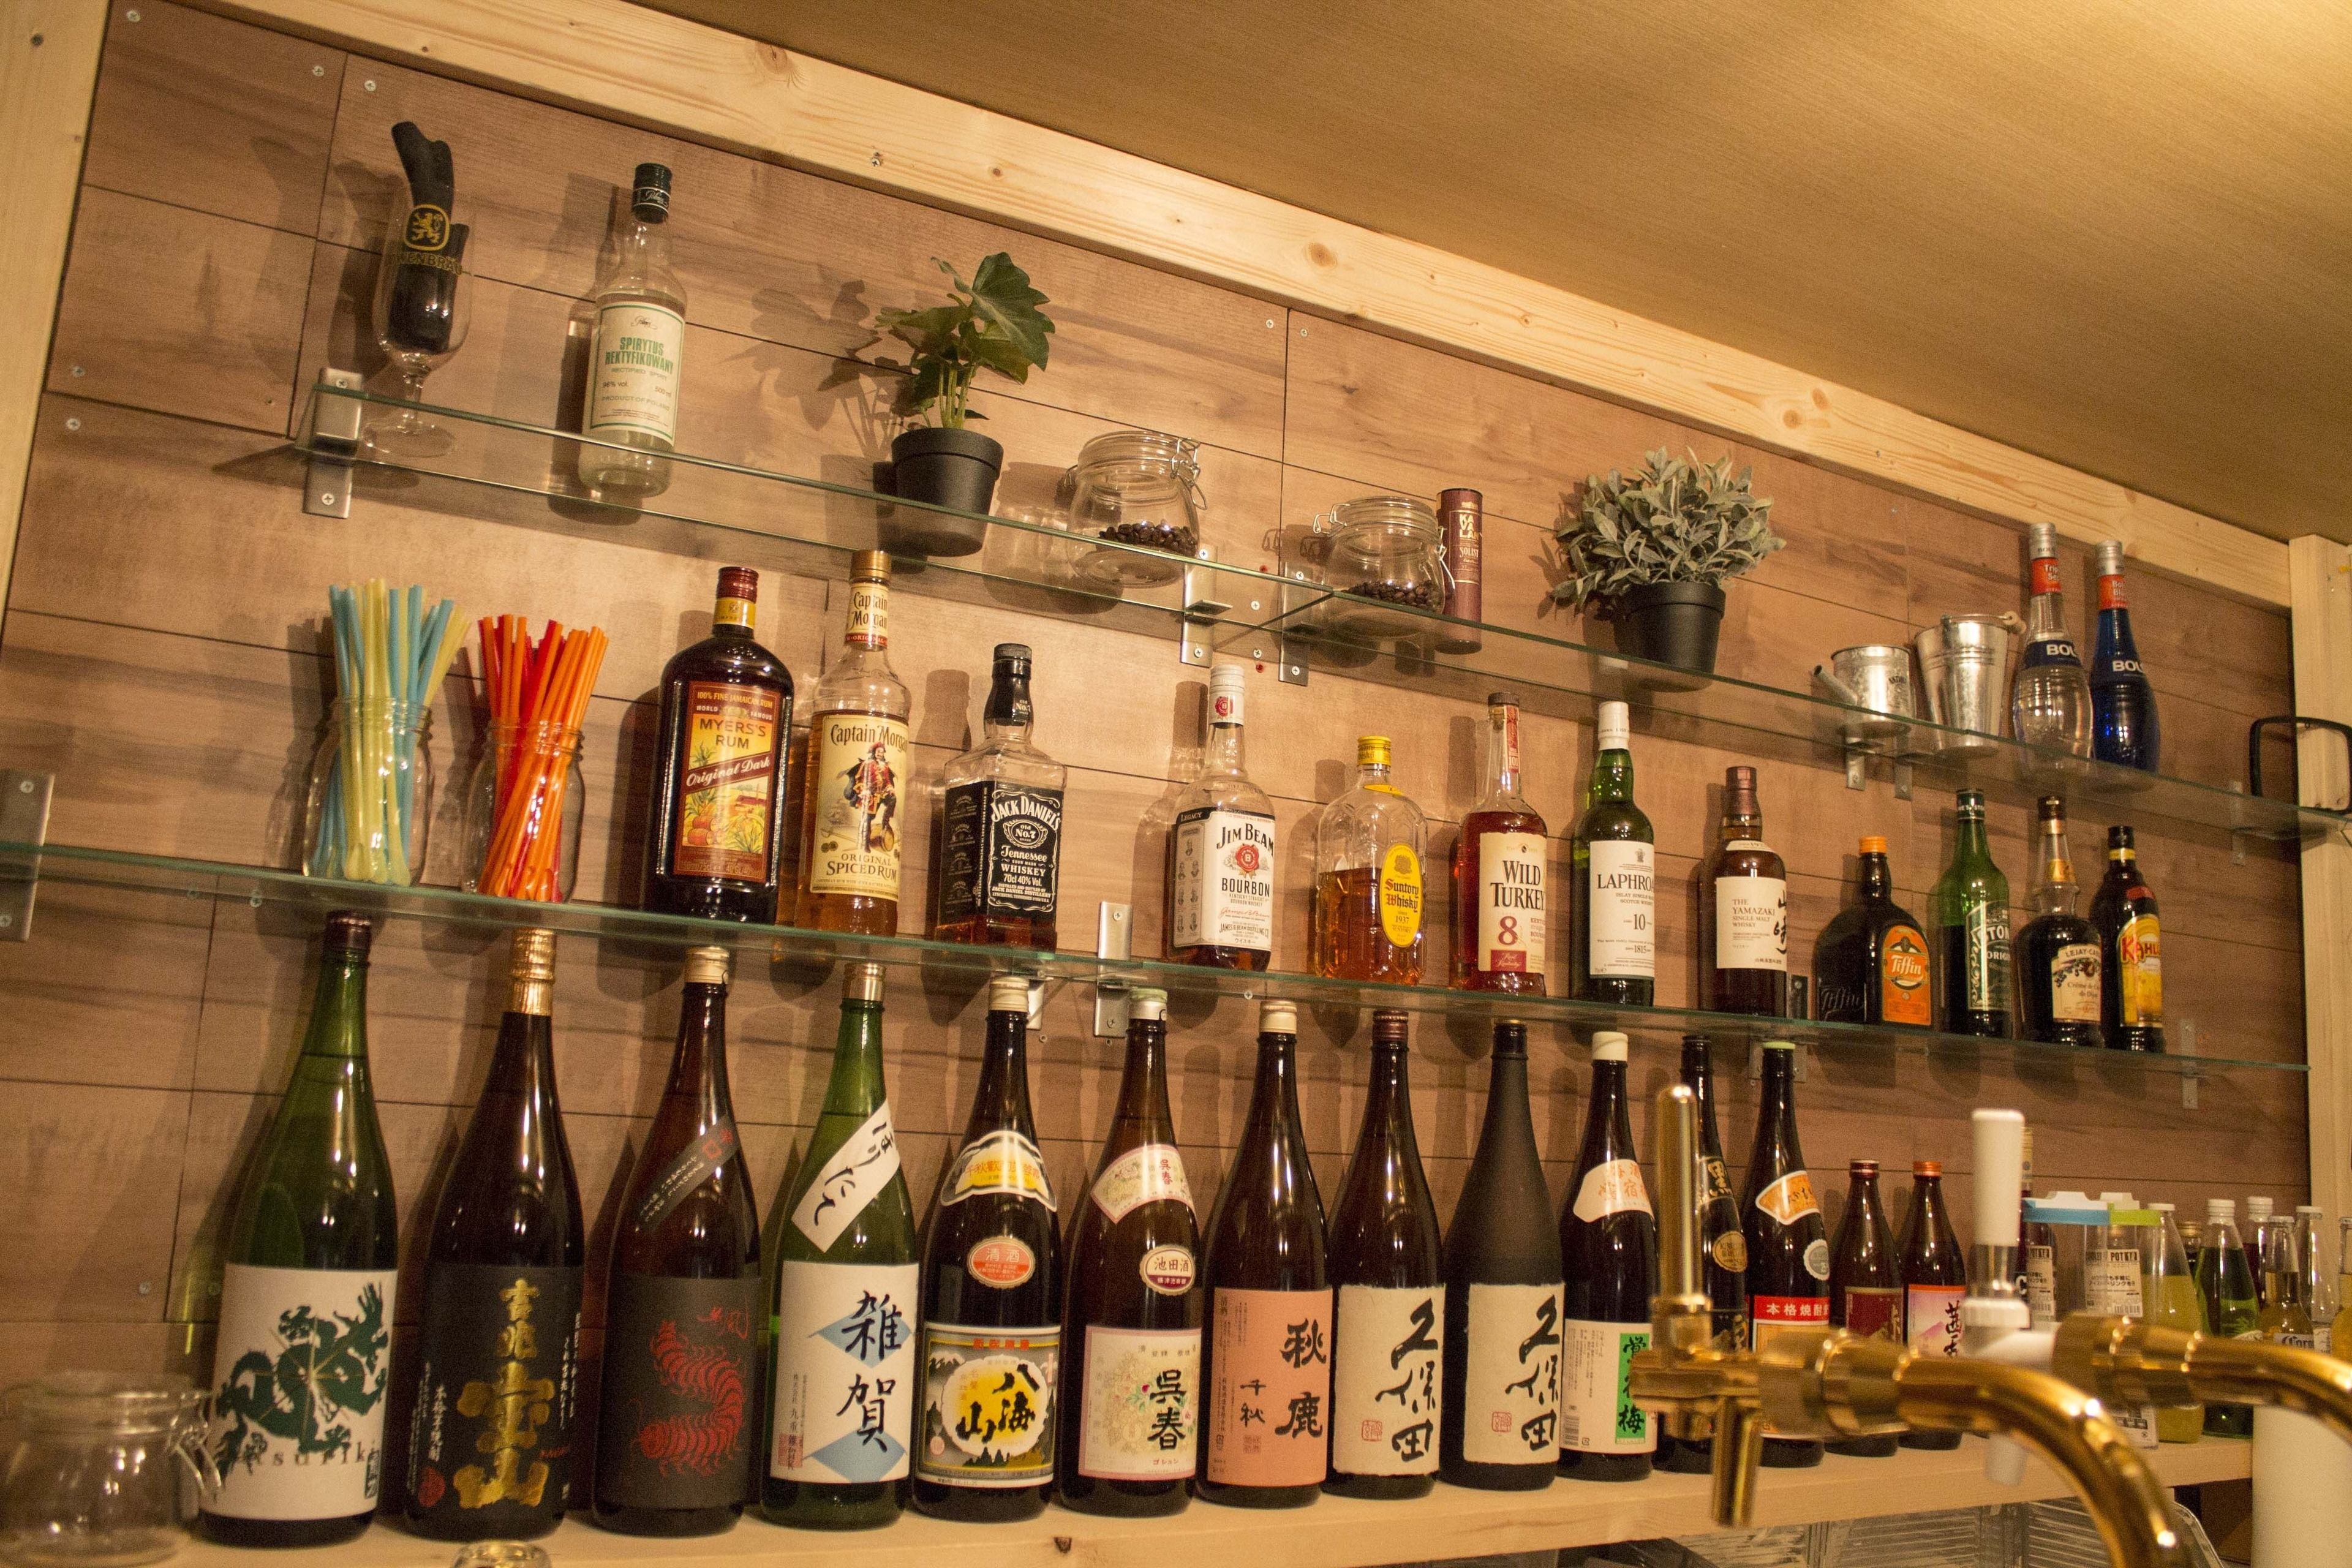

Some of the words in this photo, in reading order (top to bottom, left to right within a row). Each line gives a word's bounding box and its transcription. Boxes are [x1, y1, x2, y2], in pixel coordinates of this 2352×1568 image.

[620, 337, 663, 355] SPIRYTUS
[605, 350, 673, 374] REKTYFIKOWANY
[646, 399, 669, 411] POLAND
[1460, 547, 1479, 558] SOLIST
[846, 611, 887, 630] Mogan
[2046, 644, 2077, 657] BOL
[697, 692, 712, 700] 100%
[714, 693, 728, 701] FINE
[730, 695, 759, 706] JAMAICAN
[760, 699, 772, 709] RUM
[750, 711, 772, 720] FAMOUS
[699, 718, 766, 737] MYERS'S
[831, 724, 875, 745] Captain
[715, 734, 749, 750] RUM
[686, 764, 739, 788] Original
[741, 754, 770, 774] Dark
[990, 800, 1020, 822] JACK
[1021, 796, 1061, 830] DANIEL'S
[1181, 812, 1202, 822] LEGACY
[1016, 829, 1036, 839] No.7
[1216, 826, 1241, 850] JIM
[1245, 823, 1273, 857] BEAM
[842, 853, 892, 866] ORIGINAL
[1000, 845, 1047, 862] Tennessee
[826, 861, 875, 875] SPICED
[878, 865, 896, 882] RUM
[1001, 864, 1046, 876] WHISKEY
[1004, 873, 1017, 883] 70cl
[1017, 875, 1031, 885] 40%
[1503, 861, 1540, 886] WILD
[1221, 878, 1270, 897] BOURBON
[1385, 878, 1419, 899] Suntory
[1490, 882, 1545, 910] TURKEY
[1385, 894, 1418, 913] Whisky
[1733, 907, 1775, 916] YAMAZAKI
[1395, 916, 1409, 924] 1937
[1634, 914, 1645, 930] 10
[1498, 916, 1518, 946] 8
[1891, 954, 1921, 974] Tiffin
[1159, 1159, 1172, 1185] 呉春
[986, 1248, 1019, 1262] 清酒
[1154, 1257, 1188, 1272] 池田酒
[837, 1291, 903, 1452] 雑賀
[1274, 1318, 1327, 1439] 秋鹿
[955, 1363, 1040, 1444] 八海山
[1147, 1370, 1187, 1450] 呉春
[1240, 1379, 1267, 1428] 千秋
